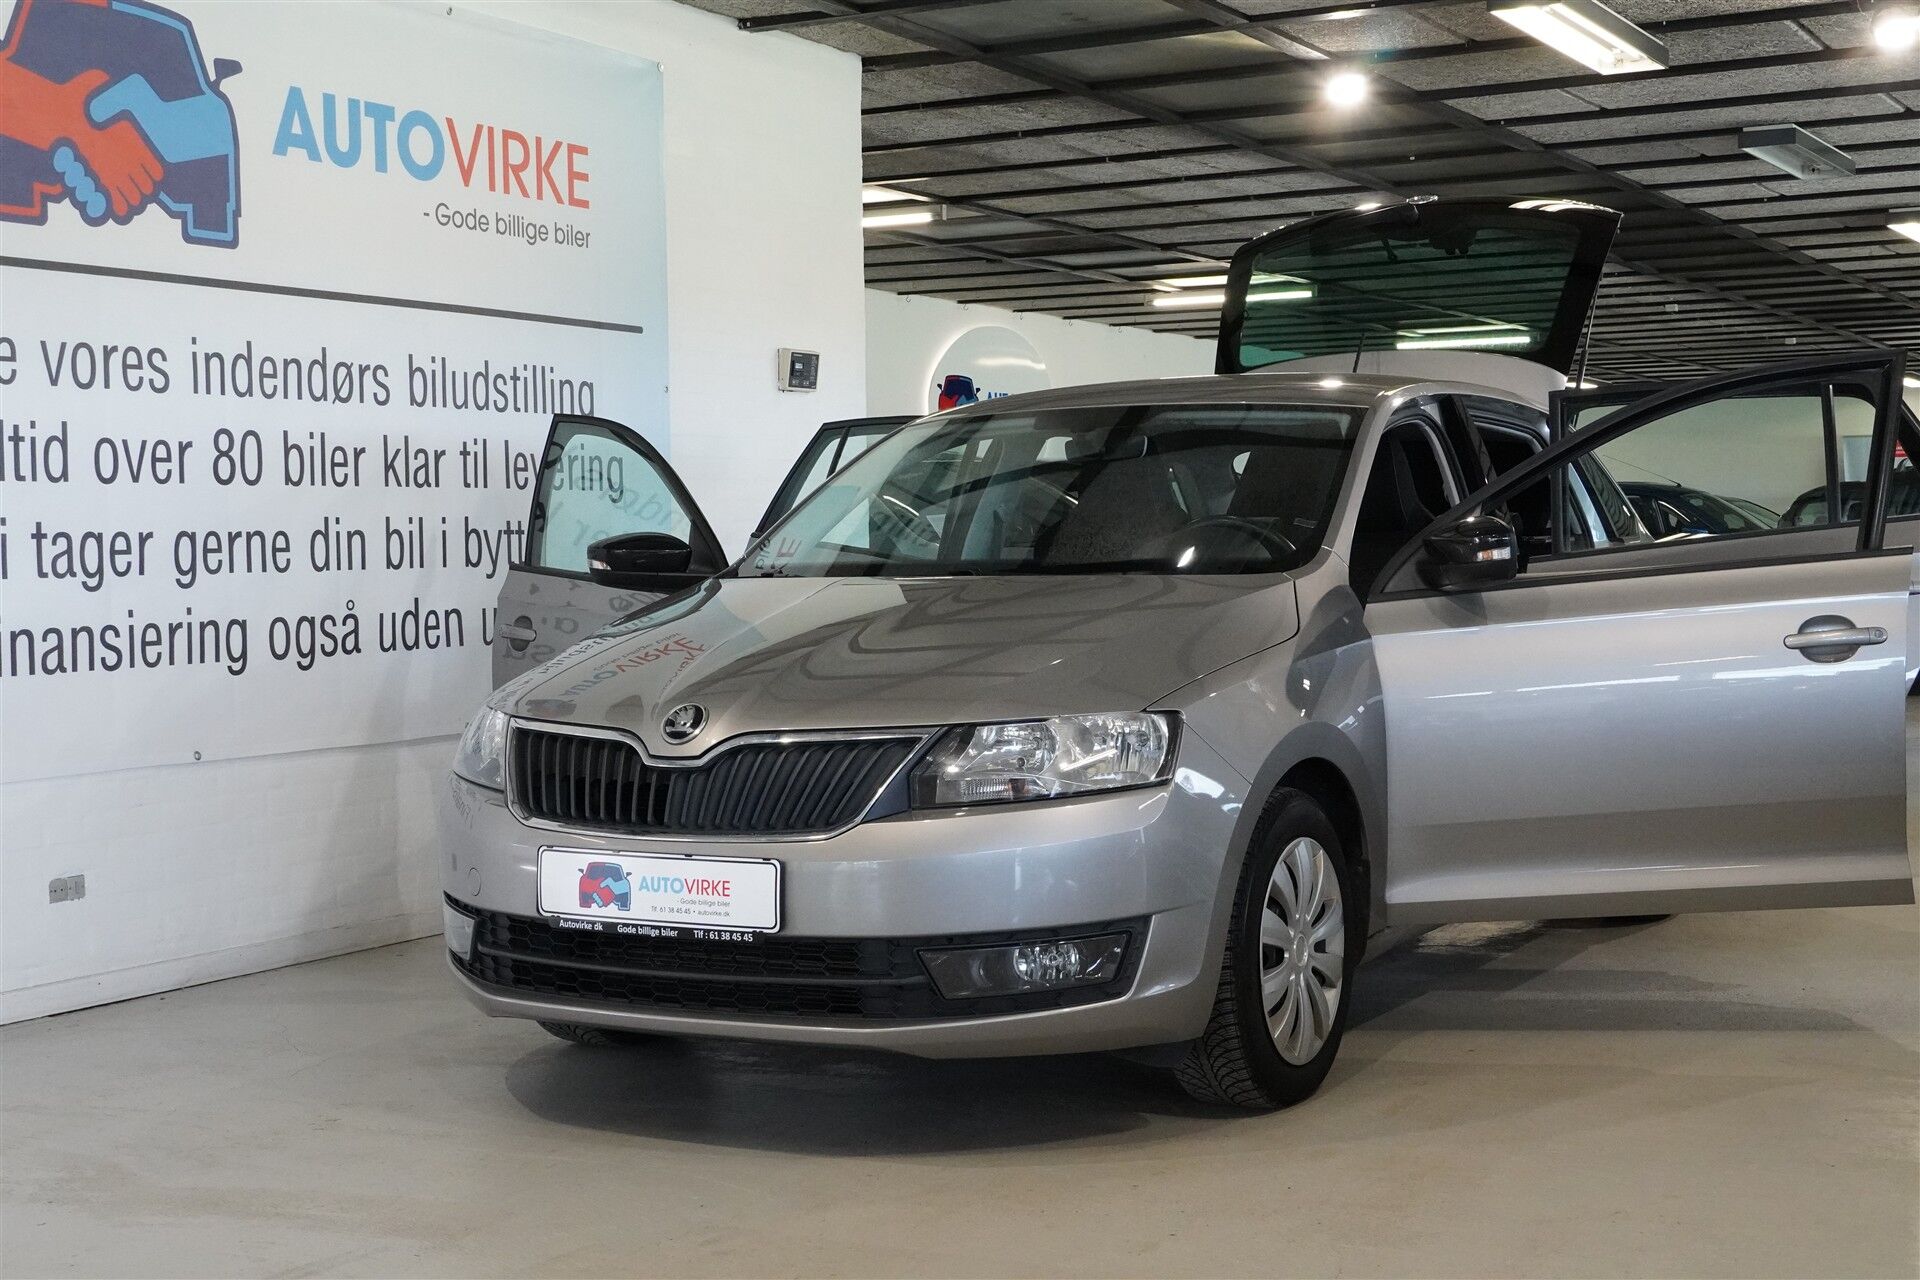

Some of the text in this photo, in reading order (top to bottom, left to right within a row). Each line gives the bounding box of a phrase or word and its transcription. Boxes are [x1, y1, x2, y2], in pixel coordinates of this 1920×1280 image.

[272, 85, 590, 210] AUTOVIRKE
[435, 202, 490, 233] Gode
[495, 212, 549, 246] billige
[554, 222, 591, 248] biler
[40, 338, 171, 394] vores
[191, 337, 391, 408] indendørs
[408, 354, 594, 416] biludstilling
[94, 436, 194, 485] over
[212, 428, 264, 487] 80
[283, 430, 367, 488] biler
[383, 434, 447, 489] klar
[459, 437, 489, 489] til
[31, 521, 153, 593] tager
[174, 530, 291, 590] gerne
[310, 515, 367, 573] din
[385, 515, 425, 571] bil
[441, 515, 448, 570] i
[268, 599, 362, 672] også
[378, 596, 465, 655] uden
[639, 875, 731, 898] AUTOVIRKE
[668, 906, 675, 914] 38
[680, 898, 698, 906] Gode
[698, 899, 716, 908] billige
[717, 900, 731, 908] biler
[559, 919, 593, 931] Autovirke
[617, 924, 637, 935] Gode
[638, 925, 660, 937] billige
[661, 927, 678, 937] biler
[709, 931, 720, 940] 61
[721, 932, 731, 941] 38
[731, 933, 742, 941] 45
[743, 933, 753, 942] 45
